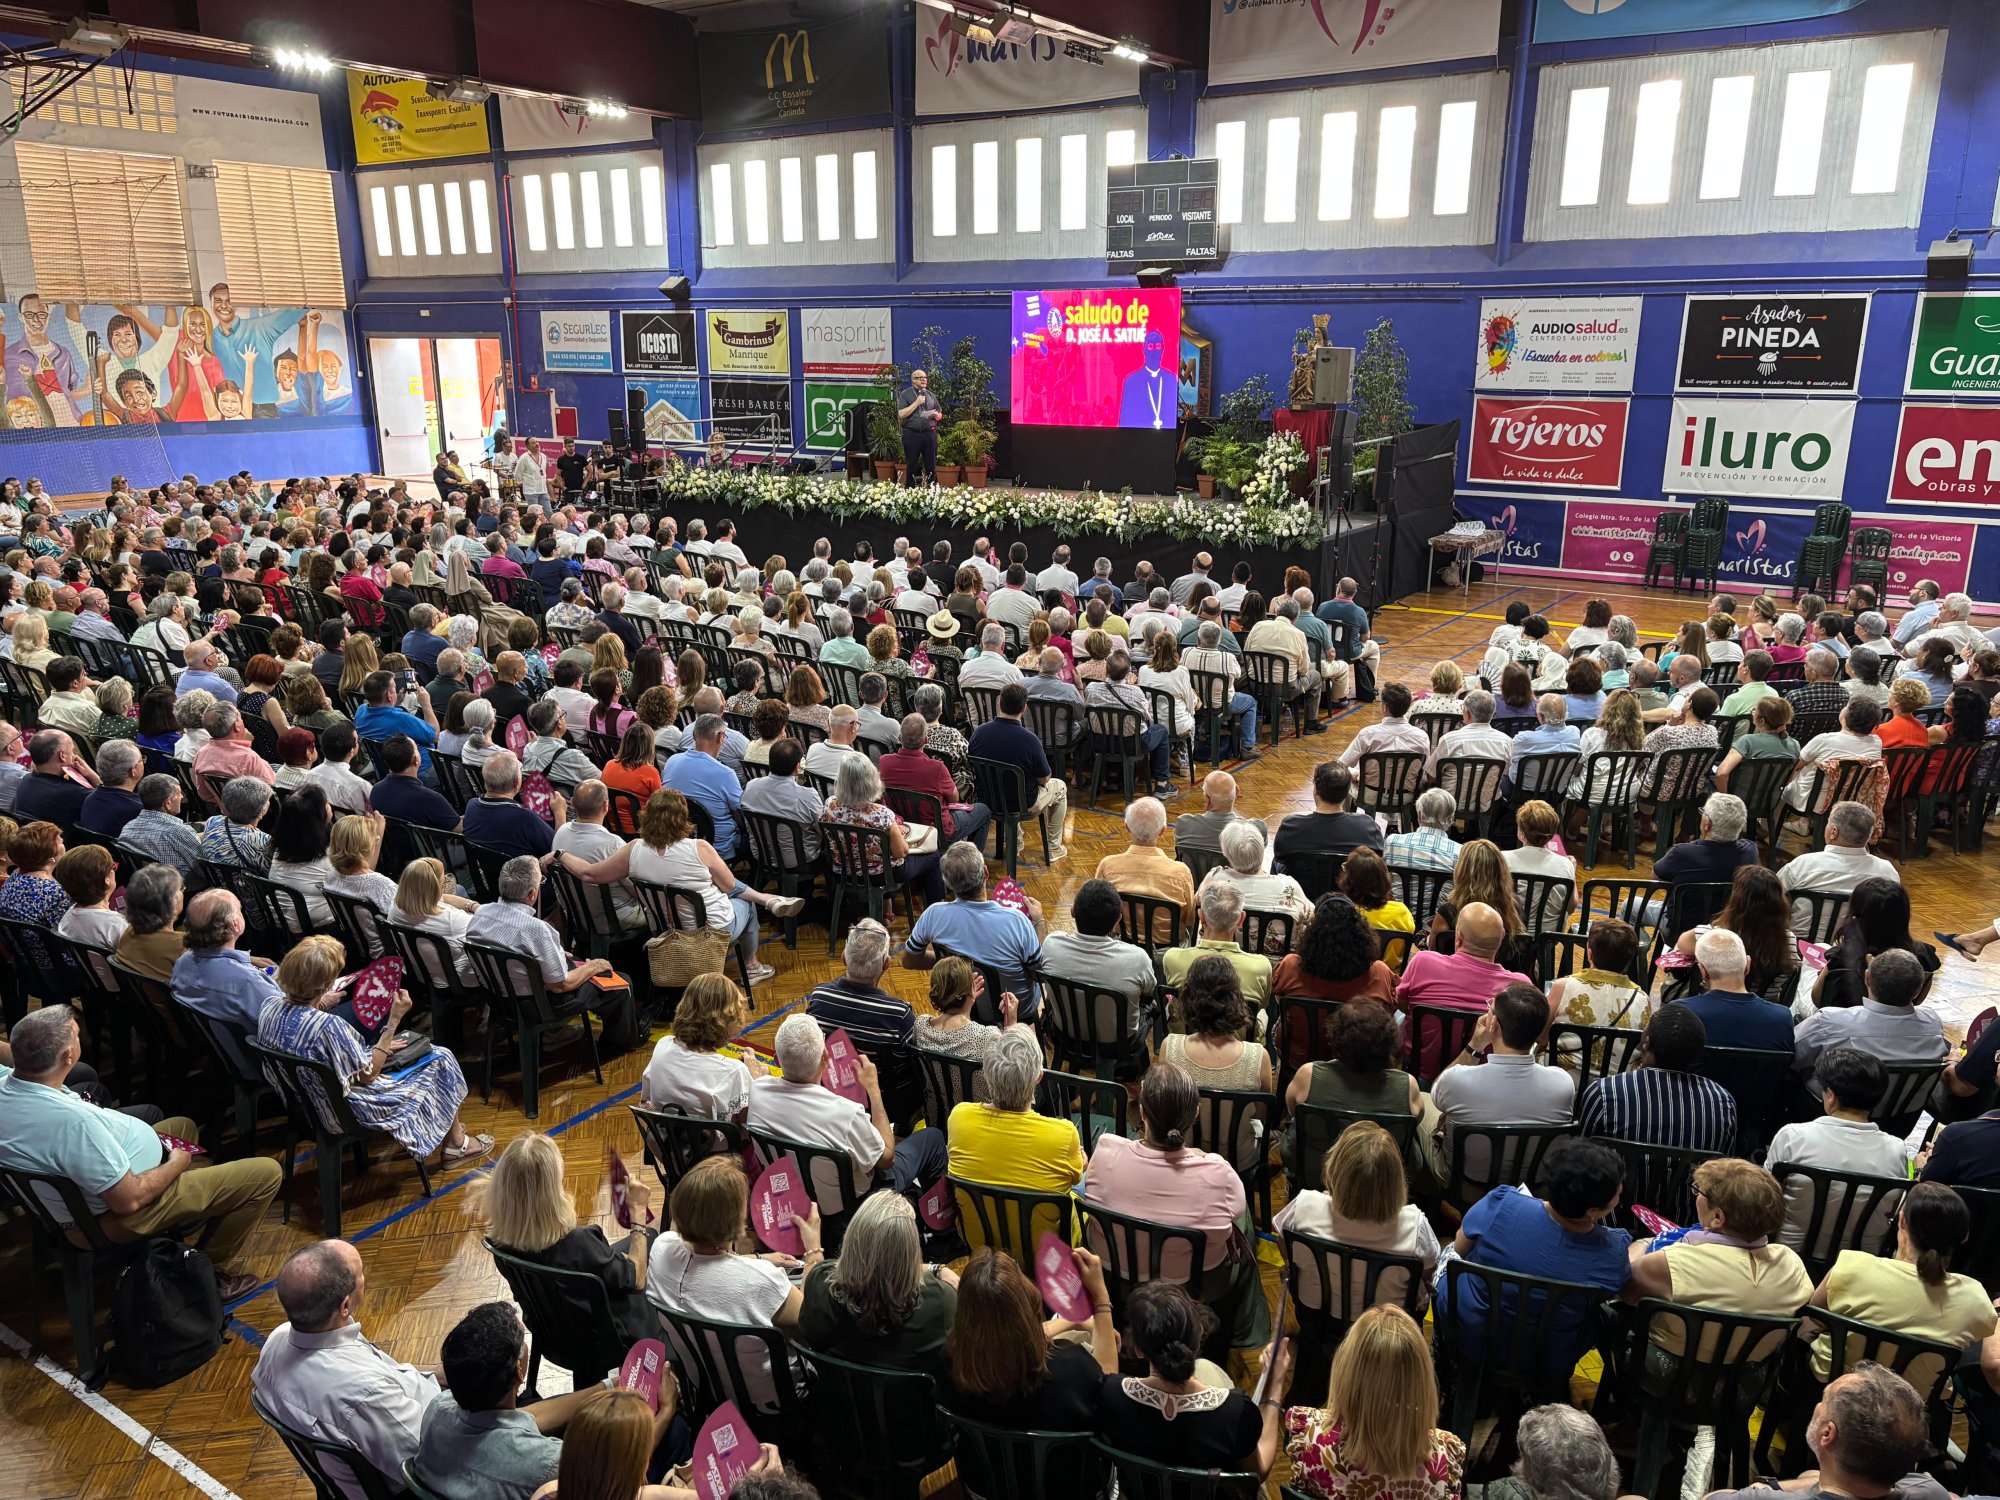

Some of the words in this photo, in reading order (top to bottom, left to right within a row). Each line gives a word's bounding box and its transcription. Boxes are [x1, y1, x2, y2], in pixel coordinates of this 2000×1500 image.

[1116, 215, 1135, 224] LOCAL
[1148, 214, 1173, 222] PERIODO
[1182, 211, 1211, 221] VISITANTE
[1106, 250, 1135, 258] FALTAS
[1185, 247, 1216, 256] FALTAS
[1065, 298, 1123, 325] saludo
[1126, 298, 1149, 325] de
[1745, 304, 1806, 325] Asador
[723, 332, 773, 347] Gambrinus
[806, 321, 887, 346] masprint
[1066, 328, 1076, 343] D.
[1077, 325, 1101, 345] JOSÉ
[1102, 328, 1113, 343] A.
[1721, 327, 1821, 348] PINEDA
[640, 333, 679, 354] ACOSTA
[729, 349, 768, 361] Manrique
[1569, 354, 1582, 362] en
[1929, 346, 2000, 376] Gua
[1951, 379, 2000, 389] INGENIERÍ
[712, 398, 745, 409] FRESH
[748, 399, 791, 410] BARBER
[1489, 415, 1607, 452] Tejeros
[1681, 416, 1832, 472] iluro
[1503, 465, 1514, 477] La
[1518, 467, 1539, 478] vida
[1555, 467, 1584, 480] dulce
[1680, 470, 1746, 481] PREVENCIÓN
[1762, 474, 1827, 484] FORMACIÓN
[1928, 480, 1976, 493] obras
[1983, 484, 1993, 496] y
[1575, 512, 1599, 520] Colegio
[1907, 532, 1918, 540] de
